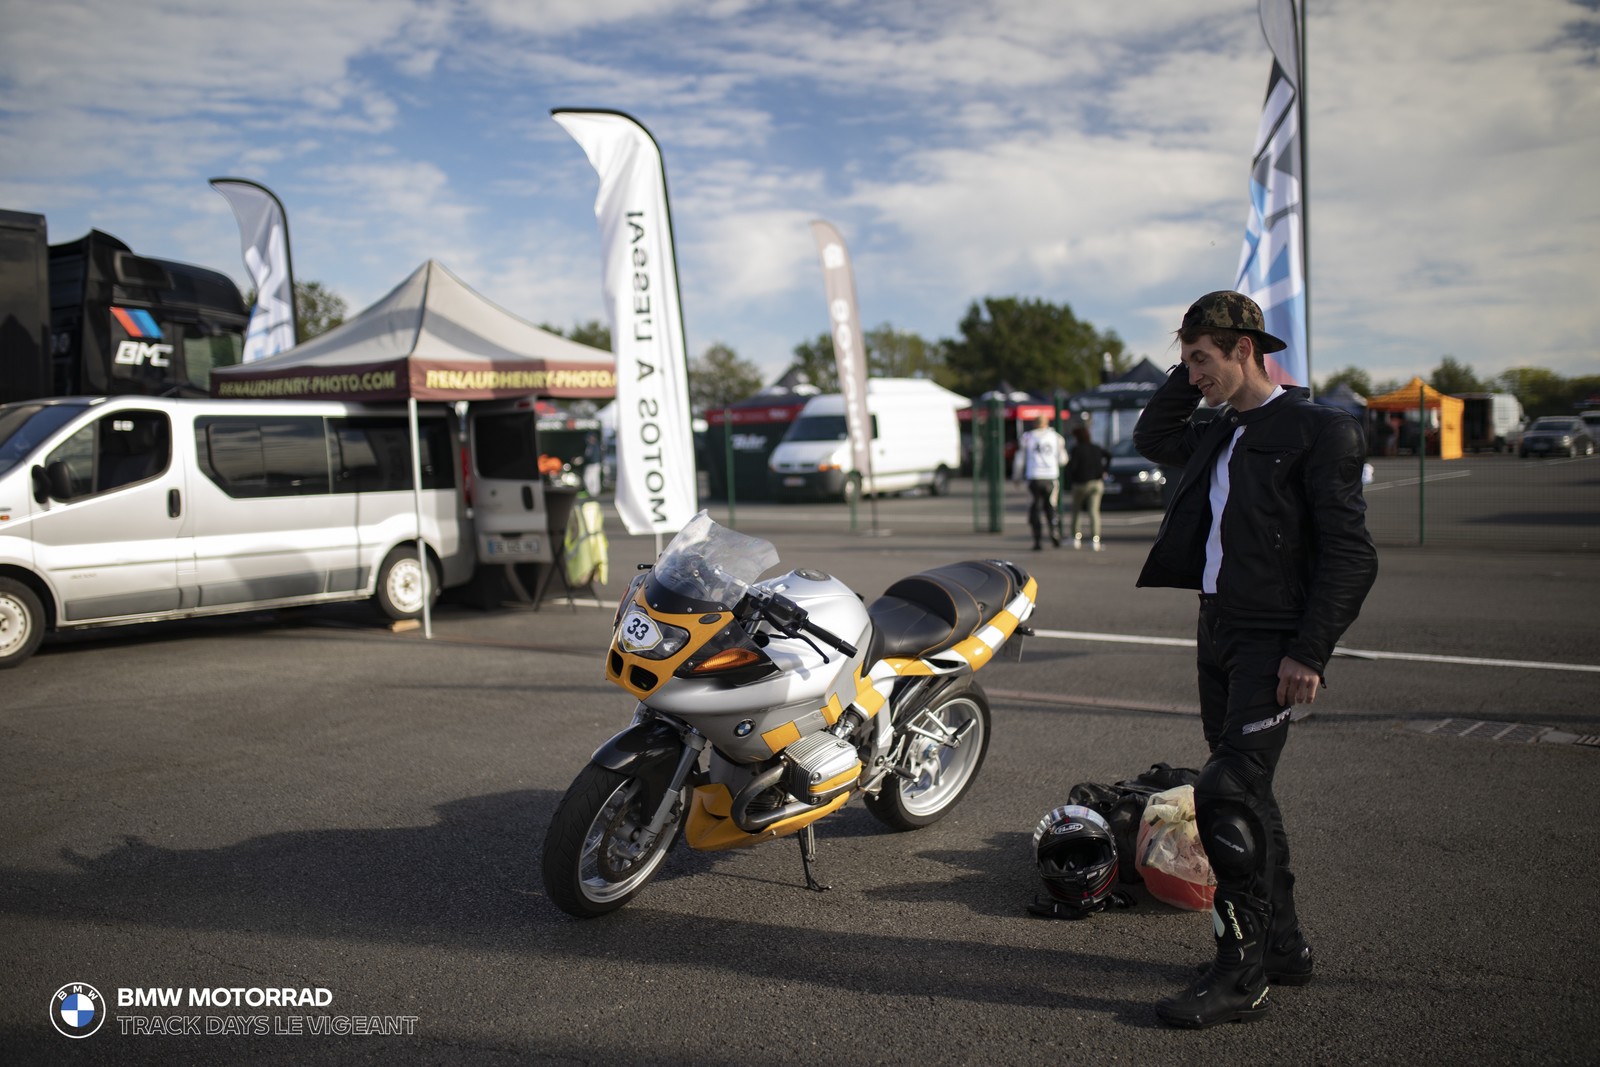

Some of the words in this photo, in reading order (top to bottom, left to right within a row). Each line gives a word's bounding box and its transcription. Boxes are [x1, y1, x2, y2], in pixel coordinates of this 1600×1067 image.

[114, 340, 174, 368] BMC
[426, 369, 617, 389] RENAUDHENRY-PHOTO.
[626, 617, 650, 641] 33
